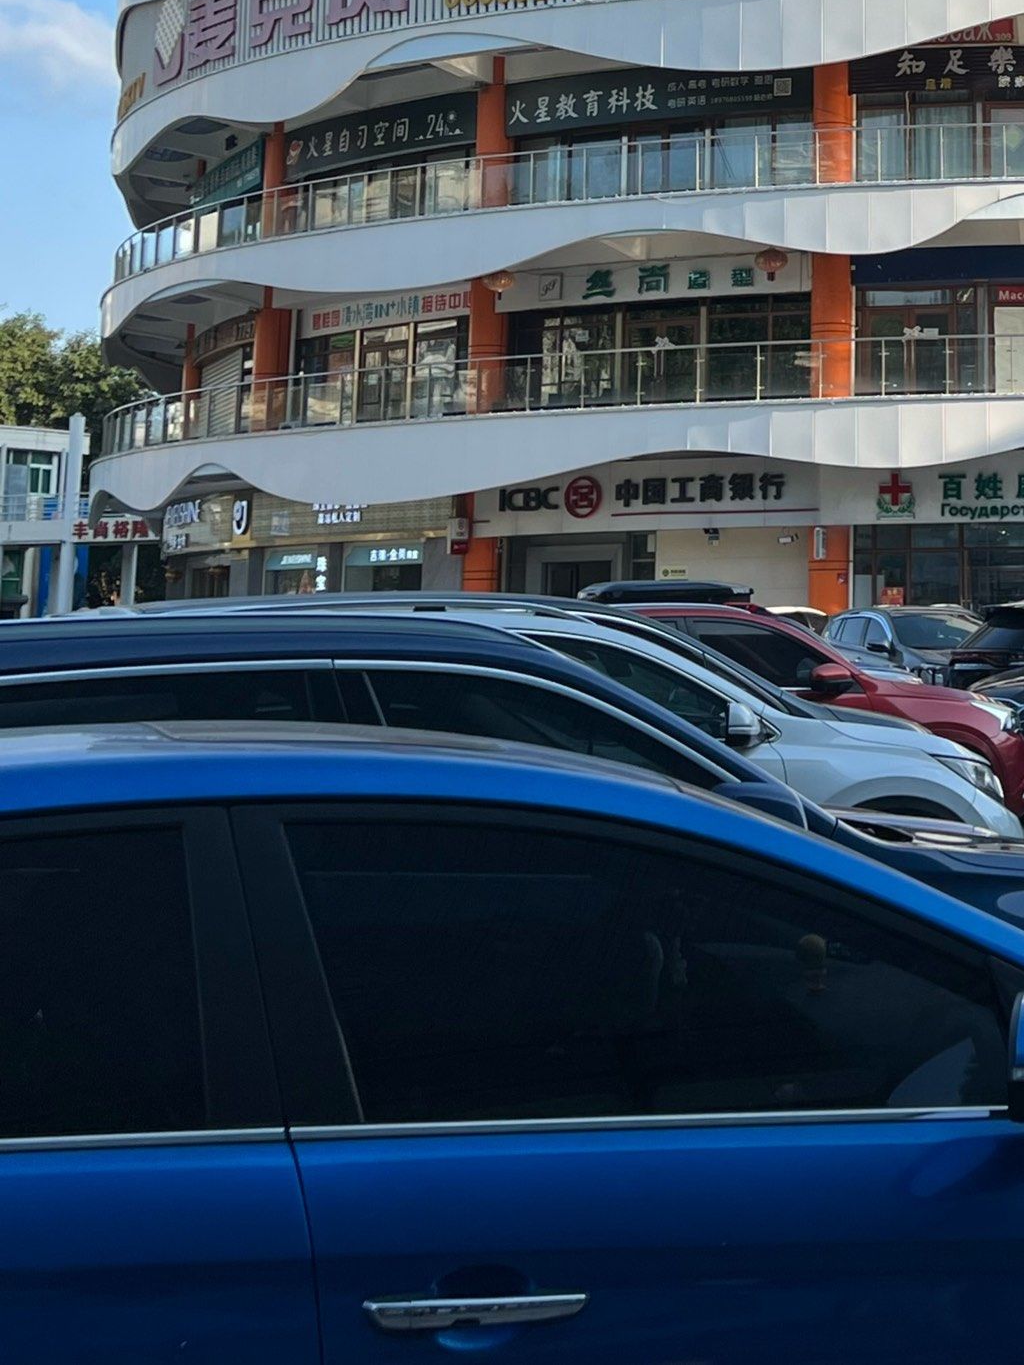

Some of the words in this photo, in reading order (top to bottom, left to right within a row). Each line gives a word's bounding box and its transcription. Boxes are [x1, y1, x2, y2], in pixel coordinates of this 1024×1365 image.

[508, 83, 659, 126] 火星教育科技
[498, 486, 560, 512] ICBC
[615, 472, 786, 508] 中国工商银行
